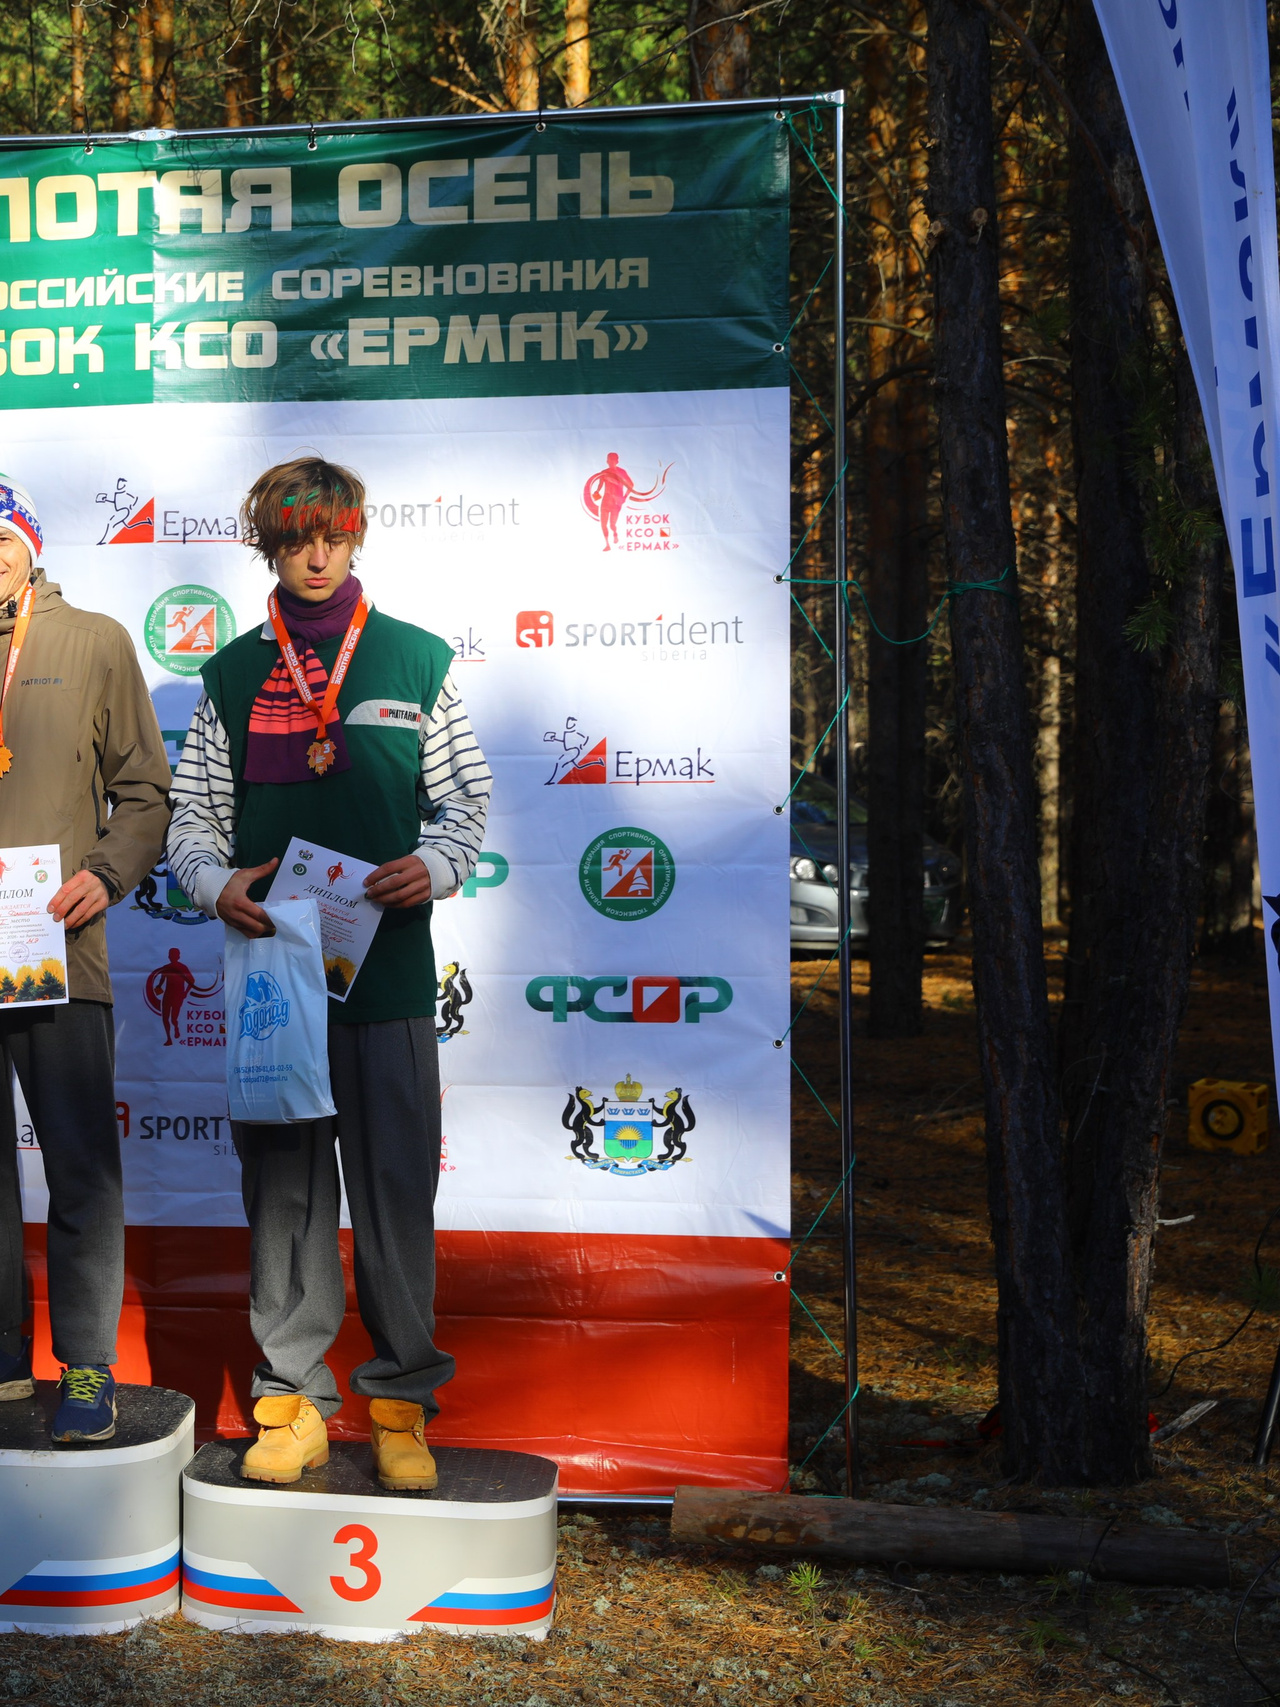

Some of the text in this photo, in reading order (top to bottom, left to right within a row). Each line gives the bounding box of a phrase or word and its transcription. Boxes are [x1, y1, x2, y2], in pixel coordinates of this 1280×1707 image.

[337, 151, 675, 229] ОСЕНЬ
[271, 256, 649, 301] СОРЕВНОВАНИЯ
[134, 320, 278, 371] КСО
[309, 309, 649, 367] «ЕРМАК»
[163, 510, 244, 544] Ерма
[365, 494, 520, 529] PORTident
[625, 513, 670, 525] КУБОК
[618, 541, 679, 552] «ЕРМАК»
[625, 527, 654, 538] КСО
[172, 588, 218, 603] СПОРТИВНОГО
[148, 596, 170, 631] ФЕДЕРАЦИЯ
[220, 606, 233, 646] ОРИЕНТИРО
[565, 612, 744, 647] SPORTident
[148, 635, 166, 661] ОБЛАСТИ
[335, 627, 360, 685] ЗОЛОТАЯ ОСЕНЬ
[21, 677, 51, 687] PATRIOT
[615, 747, 715, 786] Ермак
[583, 831, 671, 917] ФЕДЕРАЦИЯ СПОРТИВНОГО ОРИЕНТИРОВАНИЯ ТЮМЕНСКОЙ ОБЛАСТИ
[303, 884, 358, 909] ДИПЛОМ
[187, 1023, 214, 1033] КСО
[329, 1523, 382, 1603] 3
